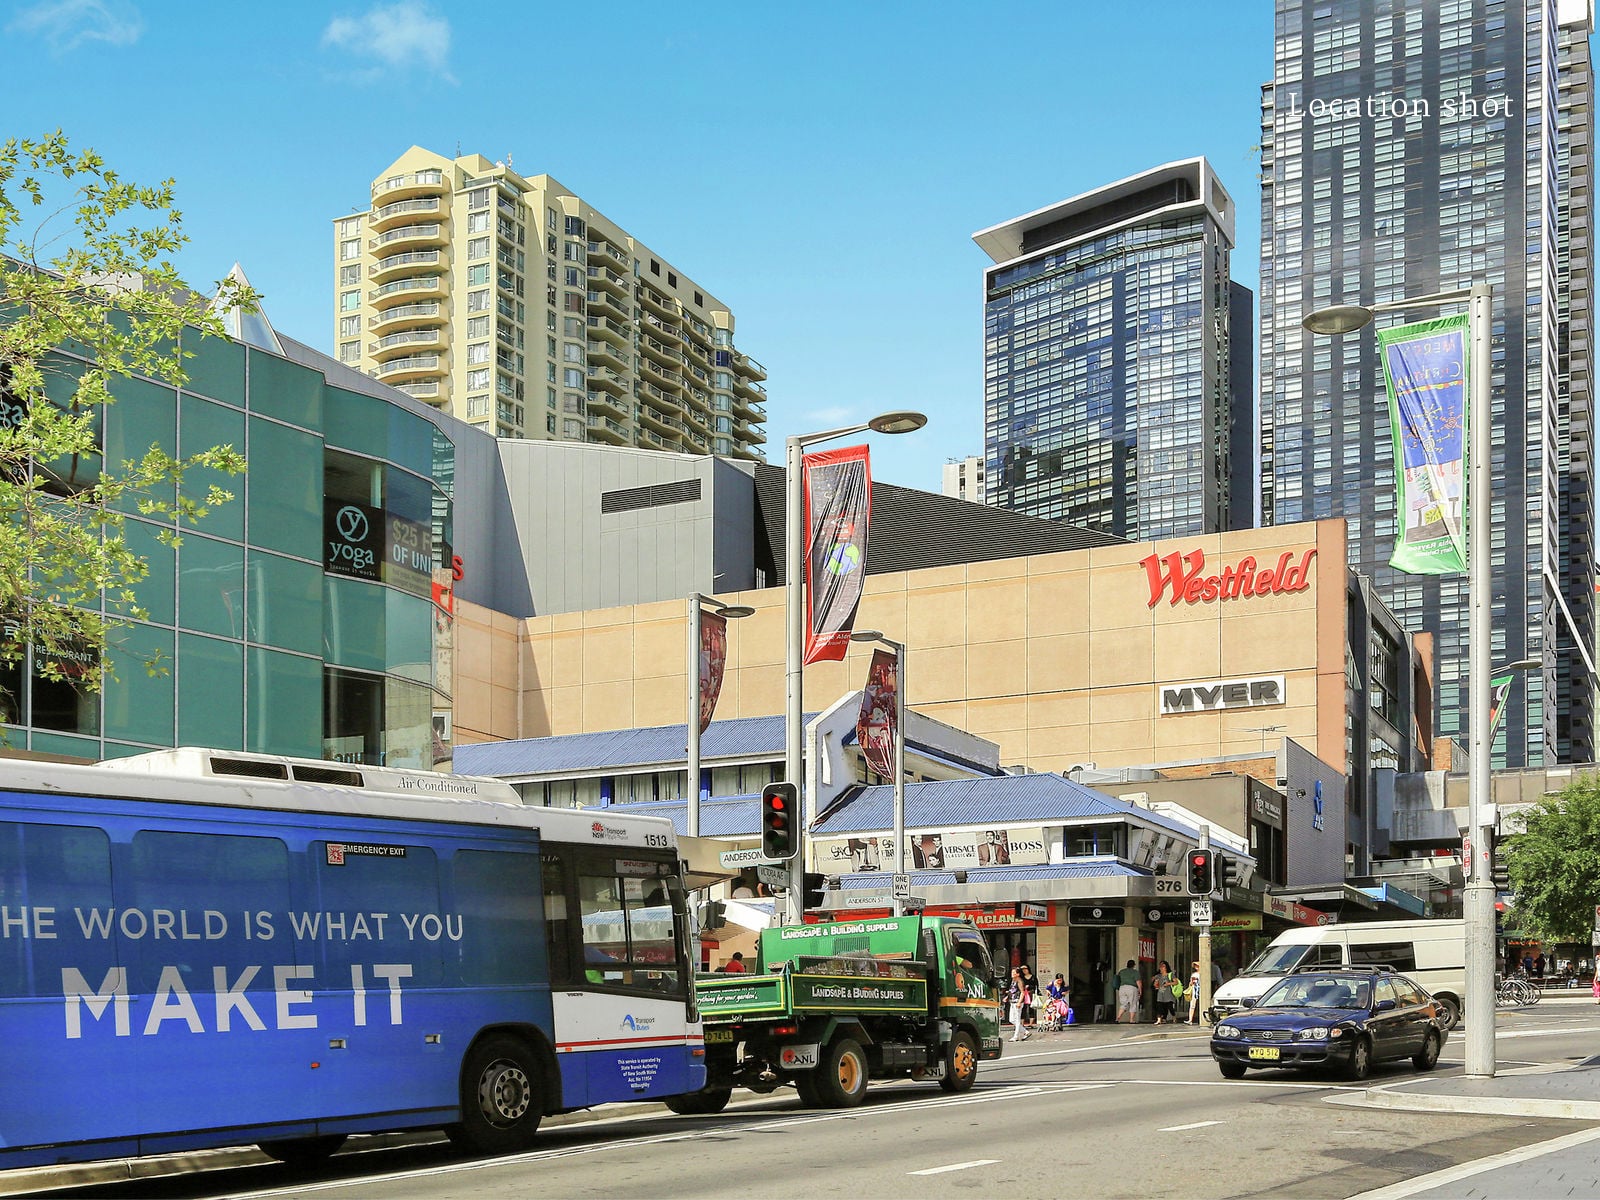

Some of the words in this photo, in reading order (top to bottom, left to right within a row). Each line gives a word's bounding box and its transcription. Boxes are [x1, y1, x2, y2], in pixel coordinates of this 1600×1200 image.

[392, 519, 418, 548] $25
[422, 531, 432, 550] F
[329, 541, 375, 569] yoga
[392, 544, 409, 565] OF
[1139, 548, 1318, 609] Westfield
[1164, 680, 1281, 712] MYER
[398, 777, 414, 789] Air
[416, 778, 478, 795] Conditioned
[644, 834, 668, 847] 1513
[1010, 840, 1043, 852] BOSS
[343, 844, 388, 855] EMERGENCY
[389, 847, 405, 856] EXIT
[944, 845, 976, 854] VERSACE
[723, 851, 763, 862] ANDERSON
[1156, 880, 1182, 892] 376
[848, 897, 877, 905] ANDERSON
[2, 906, 57, 939] HE
[74, 906, 228, 940] WORLD
[244, 910, 276, 940] IS
[288, 912, 389, 940] WHAT
[400, 914, 464, 941] YOU
[781, 926, 821, 940] LANDSCAPE
[823, 927, 829, 936] &
[831, 923, 865, 935] BUILDING
[866, 922, 899, 932] SUPPLIES
[847, 989, 852, 998] &
[967, 983, 986, 998] ANL
[61, 965, 319, 1039] MAKE
[351, 964, 414, 1027] IT
[1267, 1047, 1279, 1056] 512
[794, 1055, 815, 1064] ANL
[922, 1067, 944, 1076] ANL
